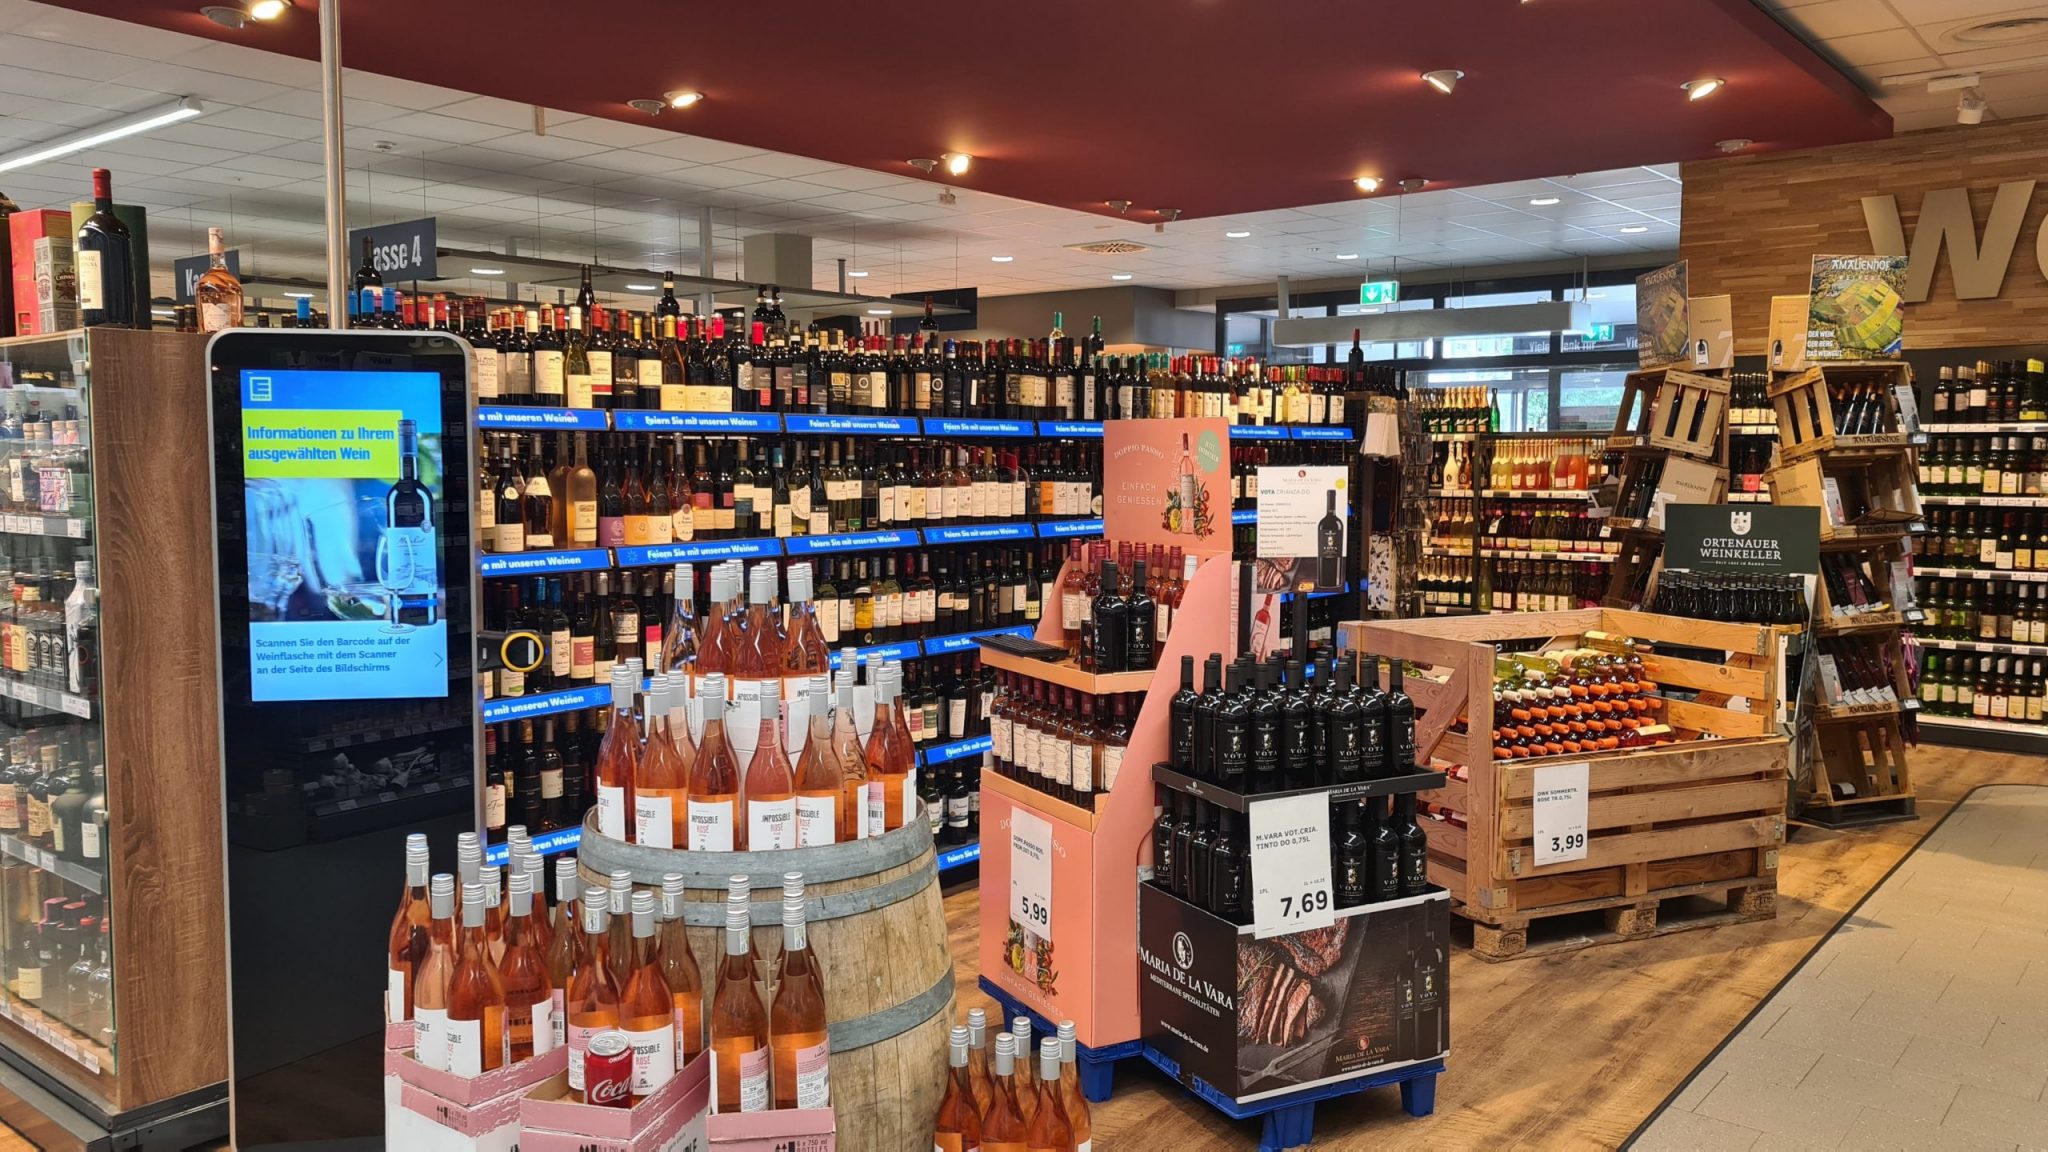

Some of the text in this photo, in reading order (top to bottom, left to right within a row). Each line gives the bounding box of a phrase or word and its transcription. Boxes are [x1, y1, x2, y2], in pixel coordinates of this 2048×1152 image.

[373, 235, 422, 272] asse 4
[488, 412, 504, 421] mit
[505, 414, 542, 423] unseren
[543, 413, 578, 423] Weinen
[671, 416, 684, 425] Sie
[685, 417, 698, 425] mit
[699, 418, 728, 426] unseren
[729, 418, 758, 427] Weinen
[247, 426, 394, 440] Informationen zu Ihrem
[248, 447, 370, 462] ausgewählten Wein
[1121, 482, 1156, 491] EINFACH
[1703, 538, 1779, 549] ORTENAUER
[673, 549, 685, 558] Sie
[686, 548, 699, 557] mit
[700, 547, 731, 556] unseren
[732, 544, 759, 554] Weinen
[1700, 548, 1782, 560] WEINKELLER
[491, 560, 507, 569] mit
[508, 558, 547, 569] unseren
[547, 555, 581, 566] Weinen
[256, 636, 410, 647] Scannen Sie den Barcode auf der
[256, 650, 397, 661] Weinflasche mit dem Scanner
[271, 665, 286, 674] der
[289, 665, 314, 674] Seite
[316, 664, 333, 673] des
[335, 663, 390, 673] Bildschirms
[494, 705, 509, 716] mit
[511, 700, 548, 713] unseren
[549, 694, 584, 707] Weinen
[761, 811, 791, 823] IMPOSSIBLE
[1256, 831, 1283, 842] M.VARA
[1256, 841, 1278, 850] TINTO
[1280, 839, 1290, 847] DO
[1551, 833, 1584, 853] 3,99
[1022, 895, 1047, 925] 5,99
[1280, 890, 1328, 919] 7,69
[1140, 946, 1233, 1011] MARIA DE LA VARA
[633, 1043, 661, 1055] POSSIBLE
